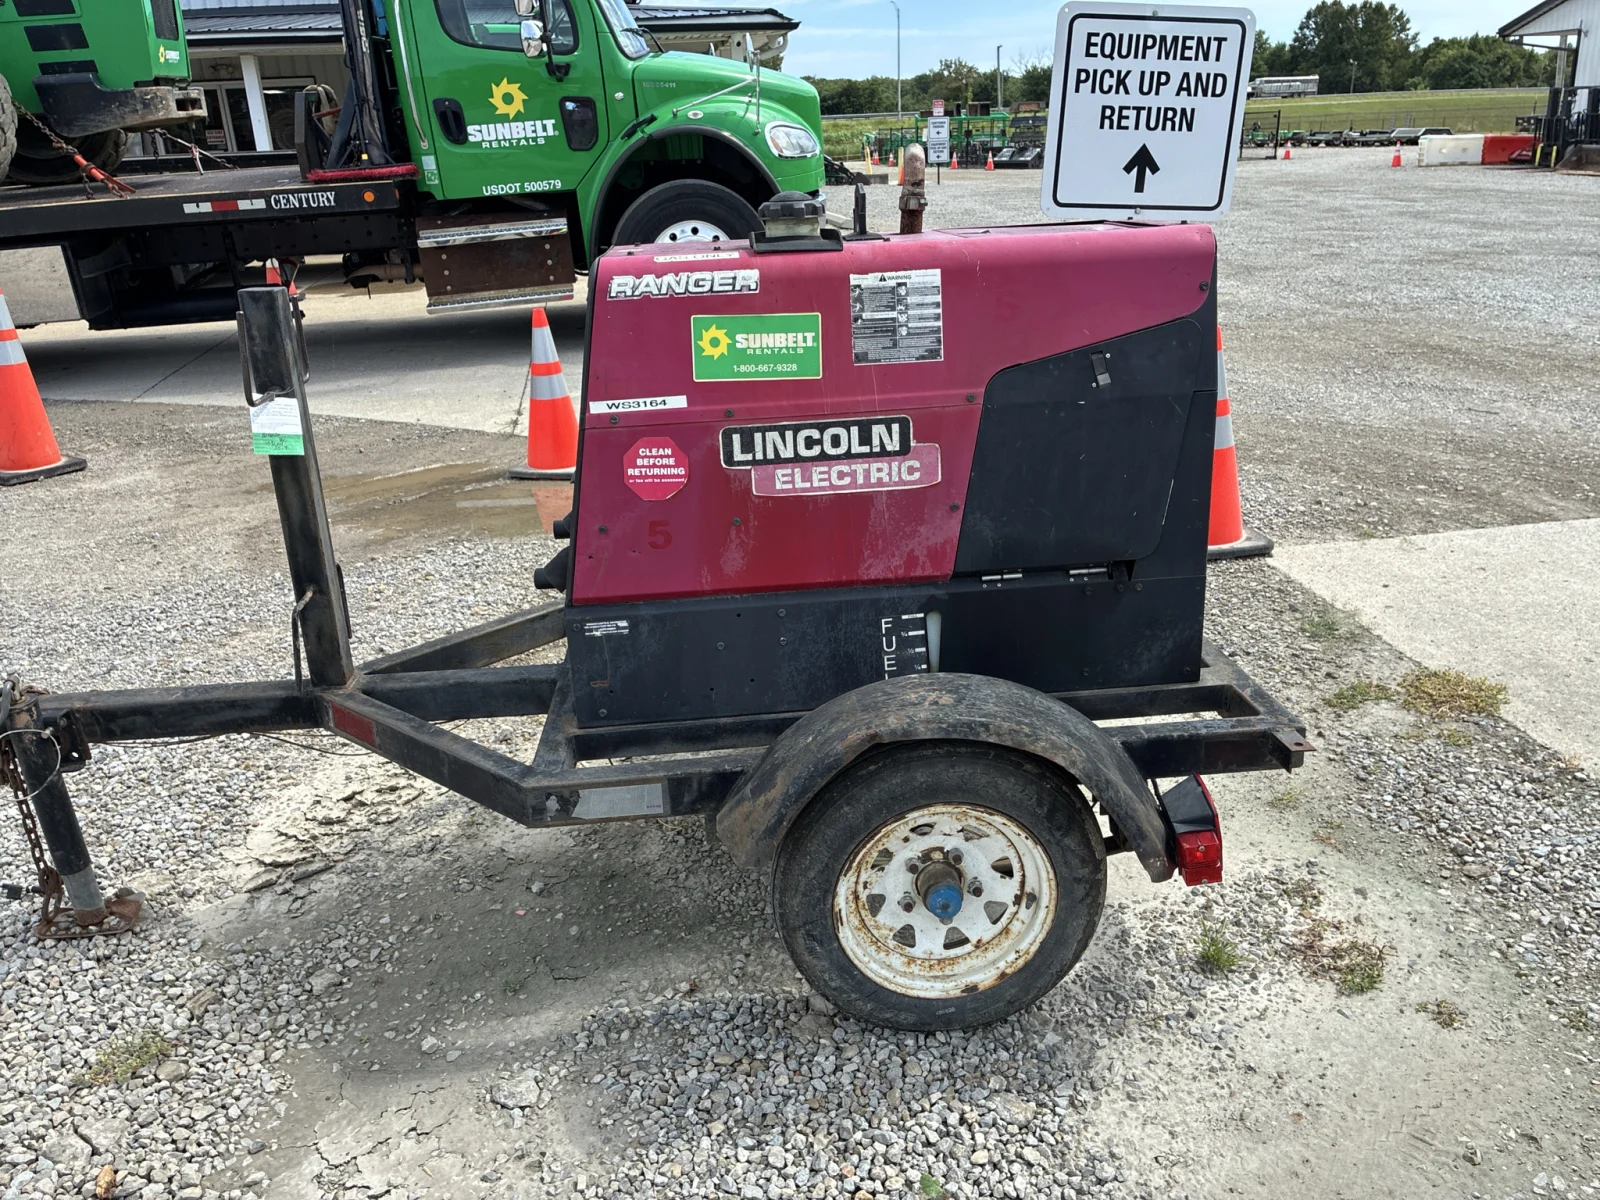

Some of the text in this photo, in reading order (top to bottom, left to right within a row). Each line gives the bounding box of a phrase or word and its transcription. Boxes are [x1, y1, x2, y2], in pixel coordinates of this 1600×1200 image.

[1085, 32, 1227, 62] EQUIPMENT
[1074, 68, 1228, 98] PICK UP AND
[1099, 105, 1196, 132] RETURN
[466, 119, 556, 142] SUNBELT
[481, 137, 545, 149] RENTALS
[482, 179, 562, 196] USDOT 500579
[270, 191, 336, 210] CENTURY
[608, 269, 759, 299] RANGER
[735, 332, 816, 349] SUNBELT
[746, 347, 804, 355] RENTALS
[733, 363, 798, 373] 1-800-667-9328
[606, 399, 668, 410] WS3164
[638, 447, 672, 456] CLEAN
[732, 423, 900, 462] LINCOLN
[636, 457, 676, 466] BEFORE
[627, 467, 685, 476] RETURNING
[775, 459, 921, 490] ELECTRIC
[648, 520, 672, 550] 5
